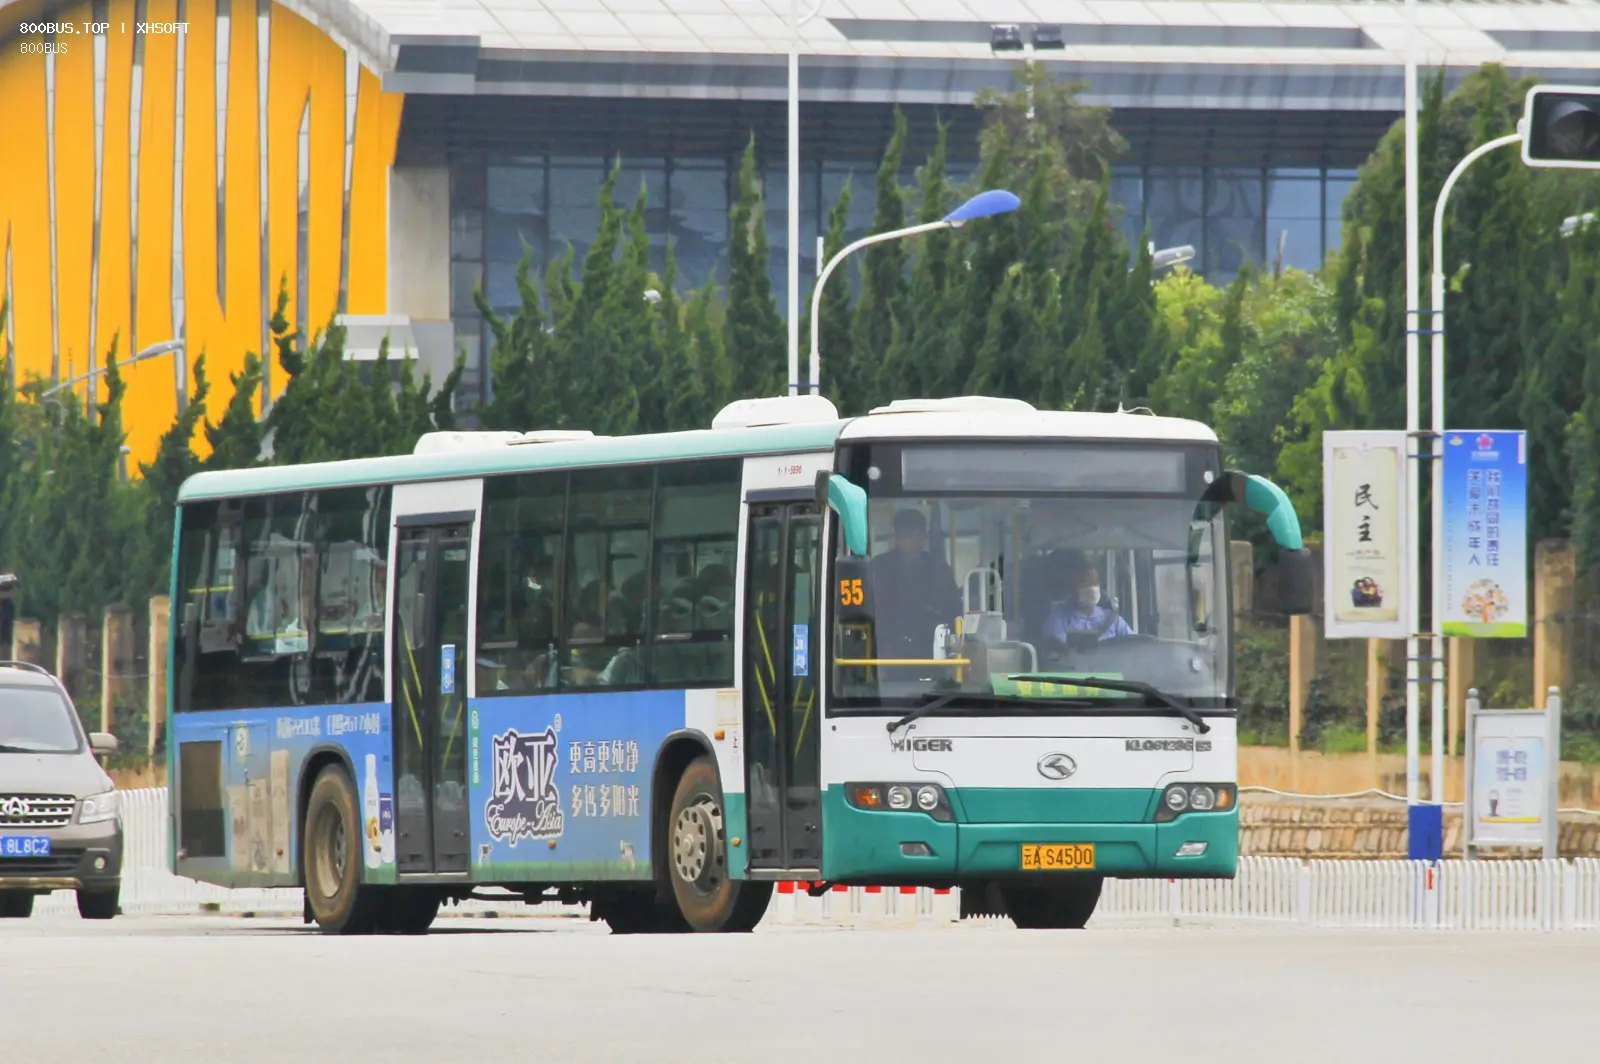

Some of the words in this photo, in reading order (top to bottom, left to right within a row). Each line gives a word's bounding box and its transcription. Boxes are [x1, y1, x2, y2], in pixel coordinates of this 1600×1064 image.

[1355, 484, 1379, 542] 民主
[840, 579, 864, 606] 55
[569, 739, 638, 775] 更高更纯净
[891, 738, 953, 752] HIGER
[494, 734, 557, 804] 欧亚
[571, 784, 640, 818] 多钙多阳光
[488, 801, 562, 845] Europe-Asia
